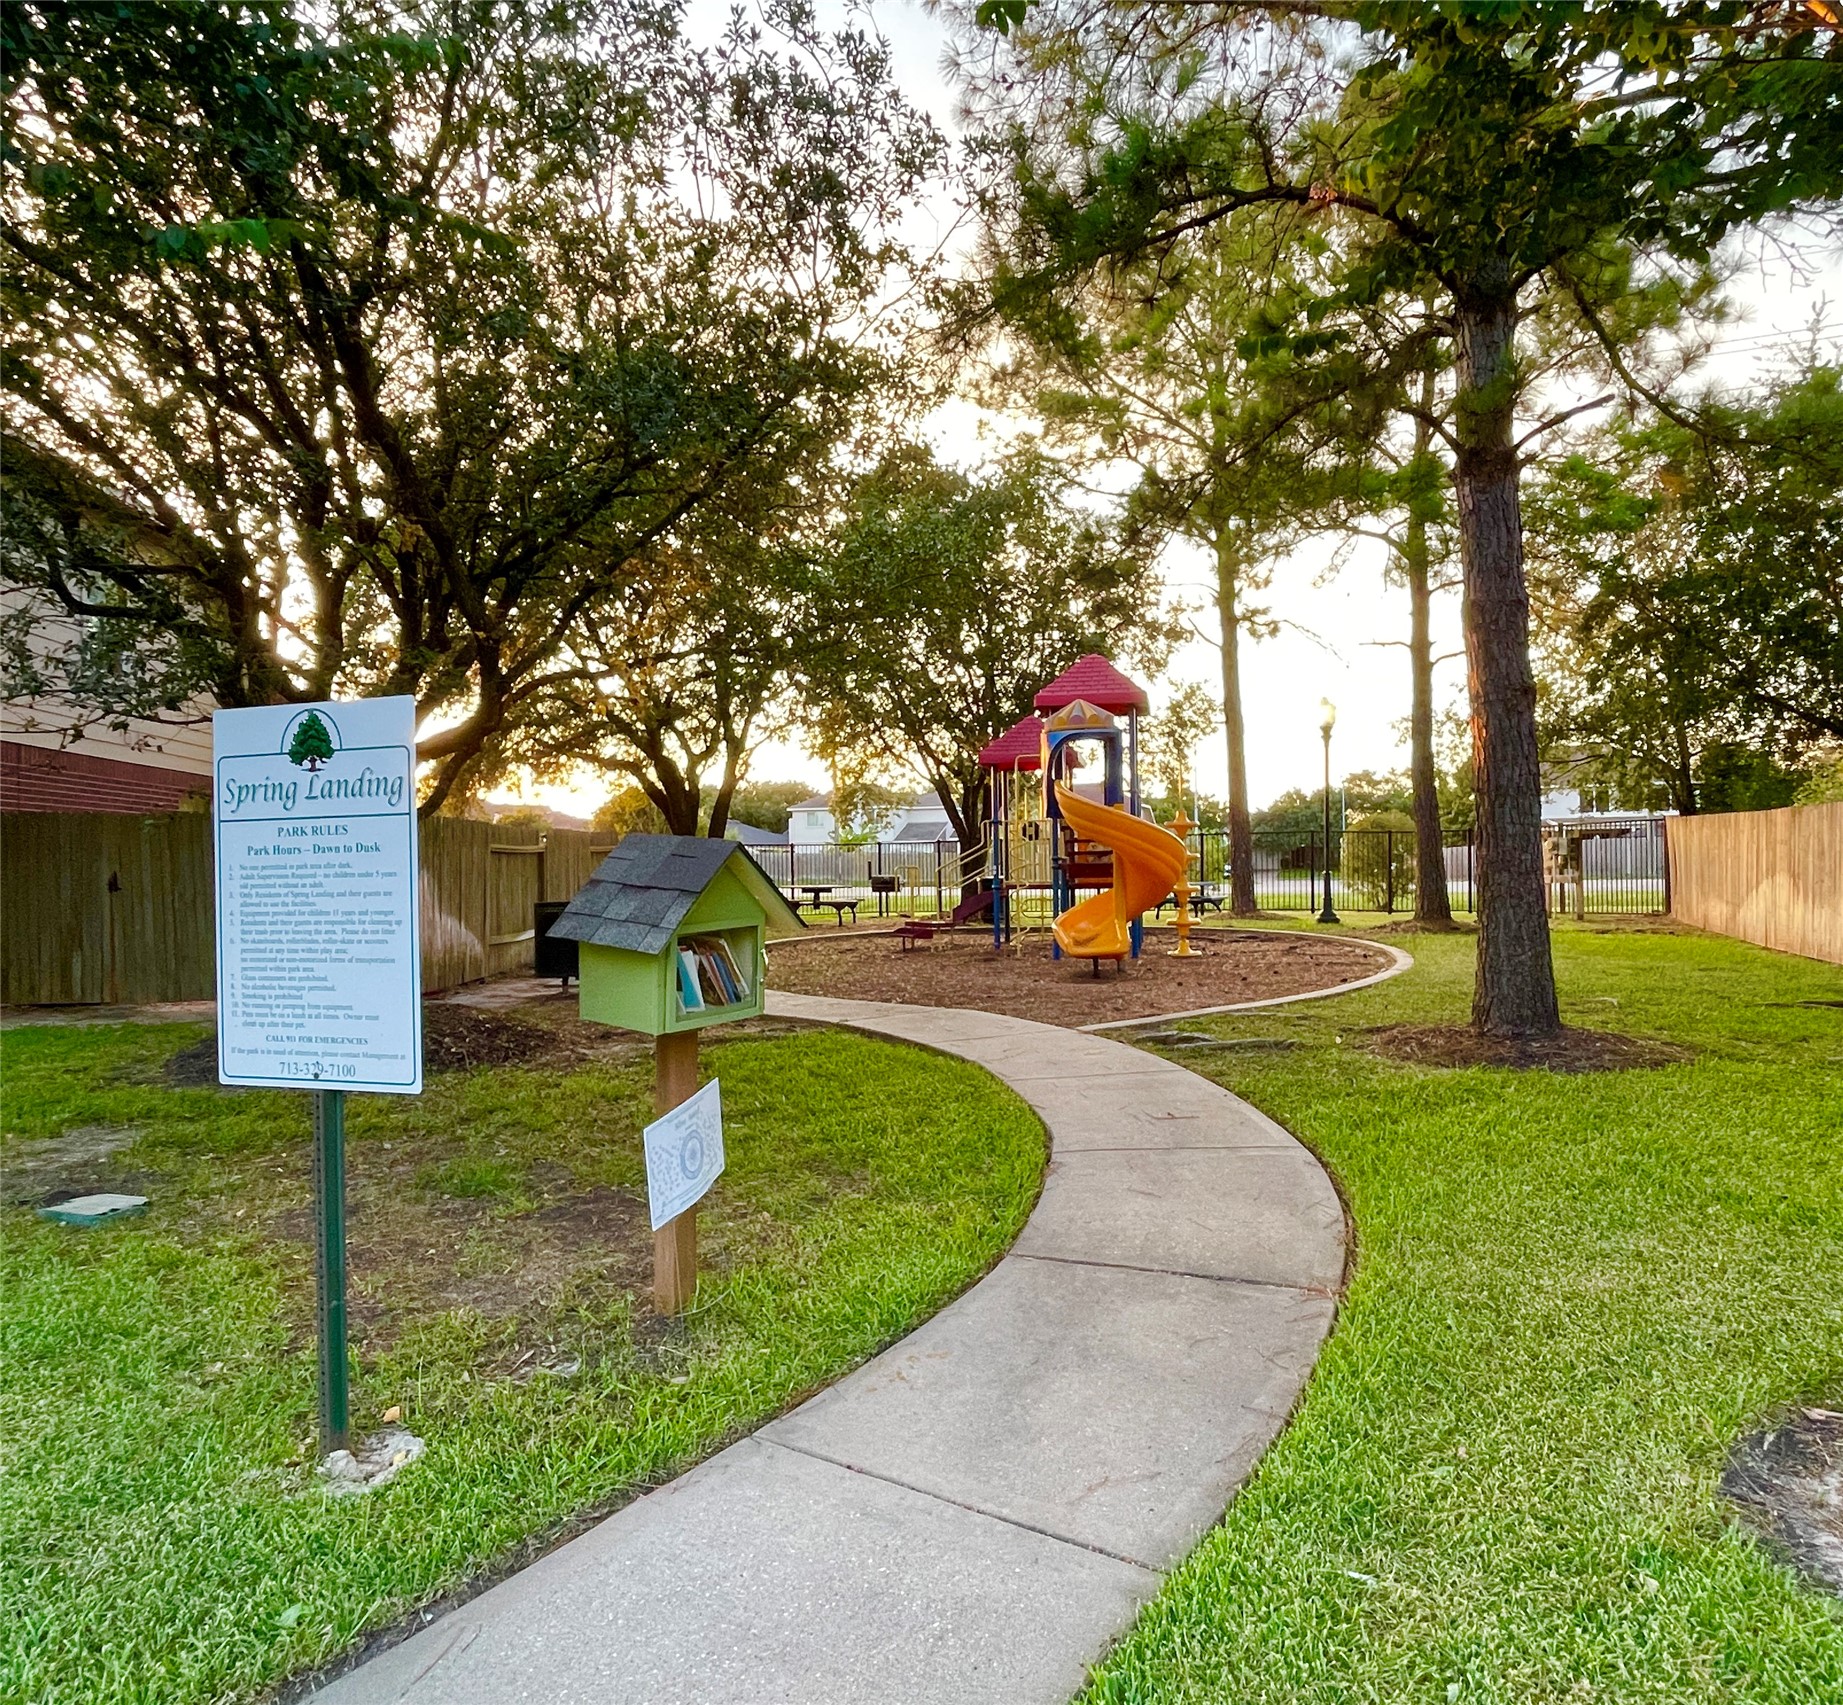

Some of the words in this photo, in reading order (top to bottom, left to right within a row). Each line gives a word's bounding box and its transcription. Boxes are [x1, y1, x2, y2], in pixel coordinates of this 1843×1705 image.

[224, 776, 298, 813] Spring
[304, 767, 404, 807] Landing
[277, 826, 308, 837] PARK
[311, 825, 349, 836] RULES
[247, 845, 270, 856] Park
[272, 845, 302, 855] Hours
[313, 843, 341, 855] Dawn
[343, 844, 353, 853] to
[355, 842, 381, 853] Dusk
[265, 1034, 285, 1043] CALL
[314, 1036, 369, 1045] EMERGENCIES
[279, 1061, 356, 1077] 713-329-7100
